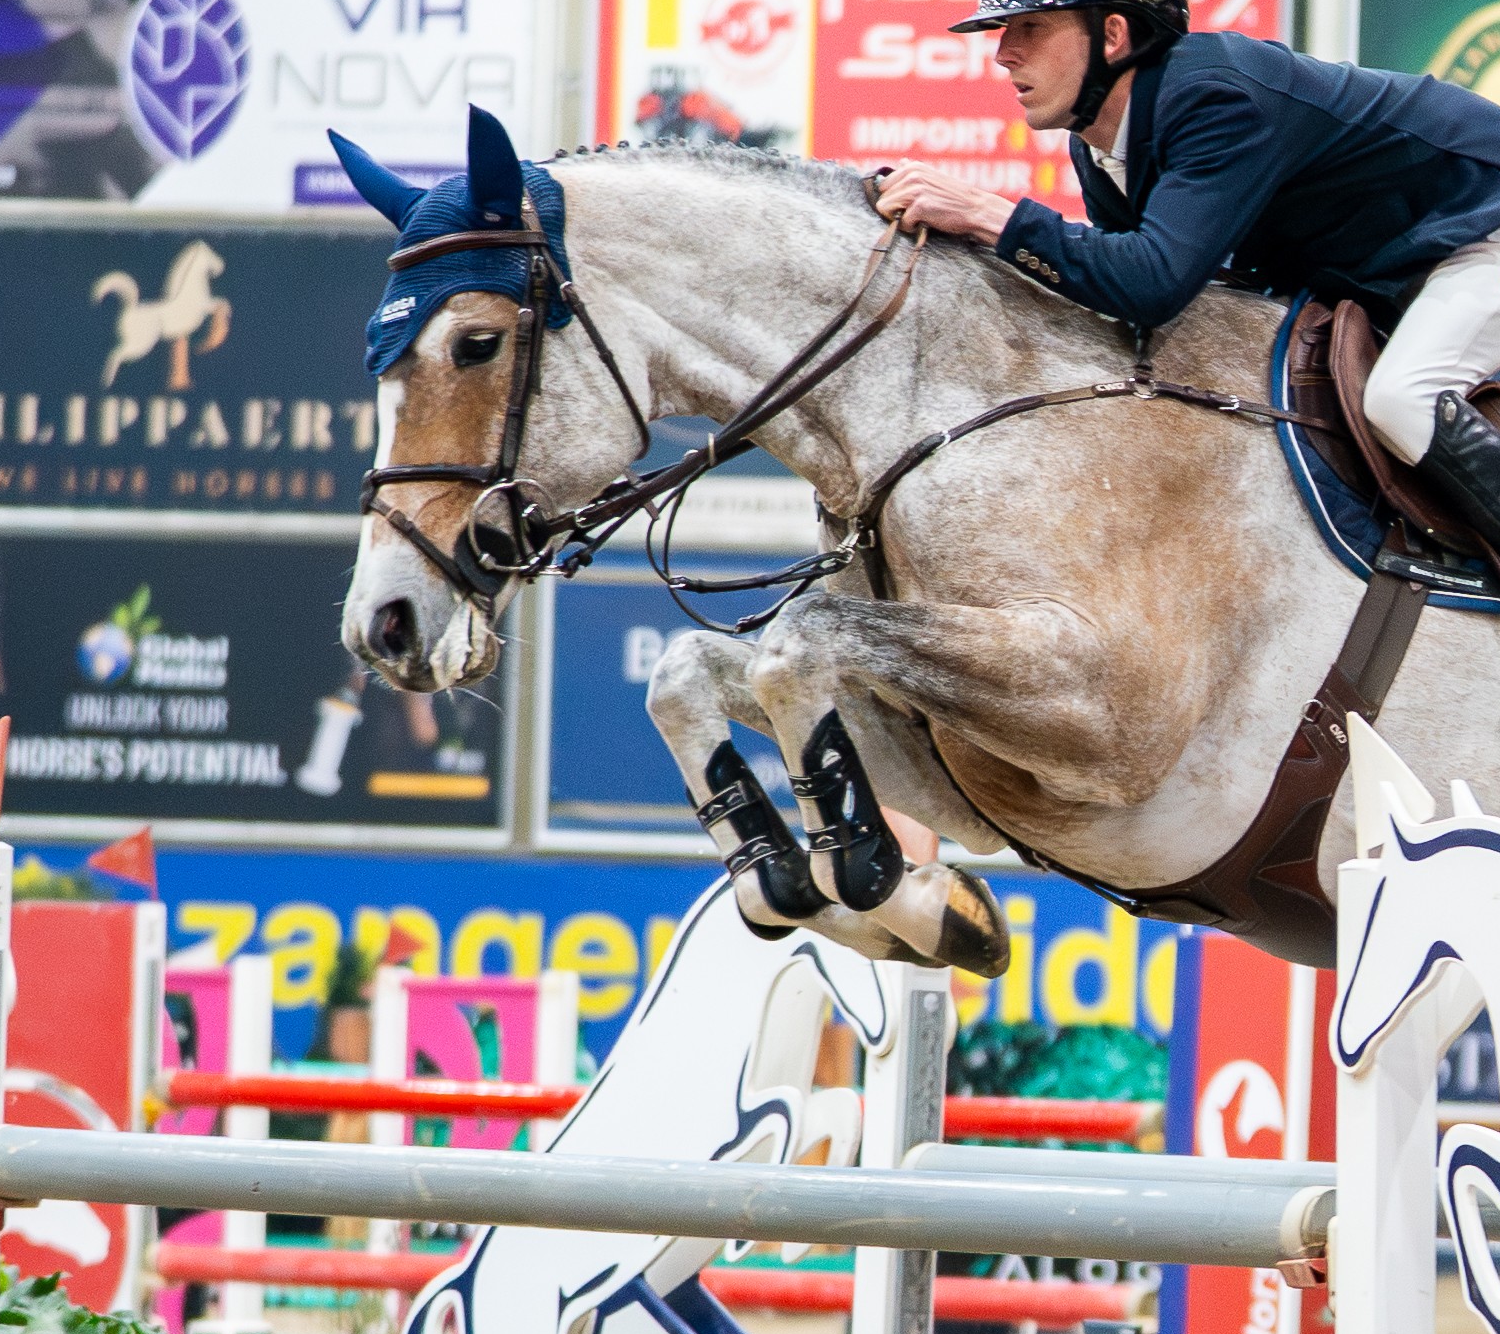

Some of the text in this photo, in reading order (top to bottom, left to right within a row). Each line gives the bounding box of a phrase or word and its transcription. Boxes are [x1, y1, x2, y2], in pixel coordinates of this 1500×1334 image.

[272, 51, 518, 110] NOVA
[851, 117, 1005, 155] IMPORT
[65, 693, 230, 734] UNLOCK YOUR
[6, 734, 289, 787] HORSE'S POTENTIAL
